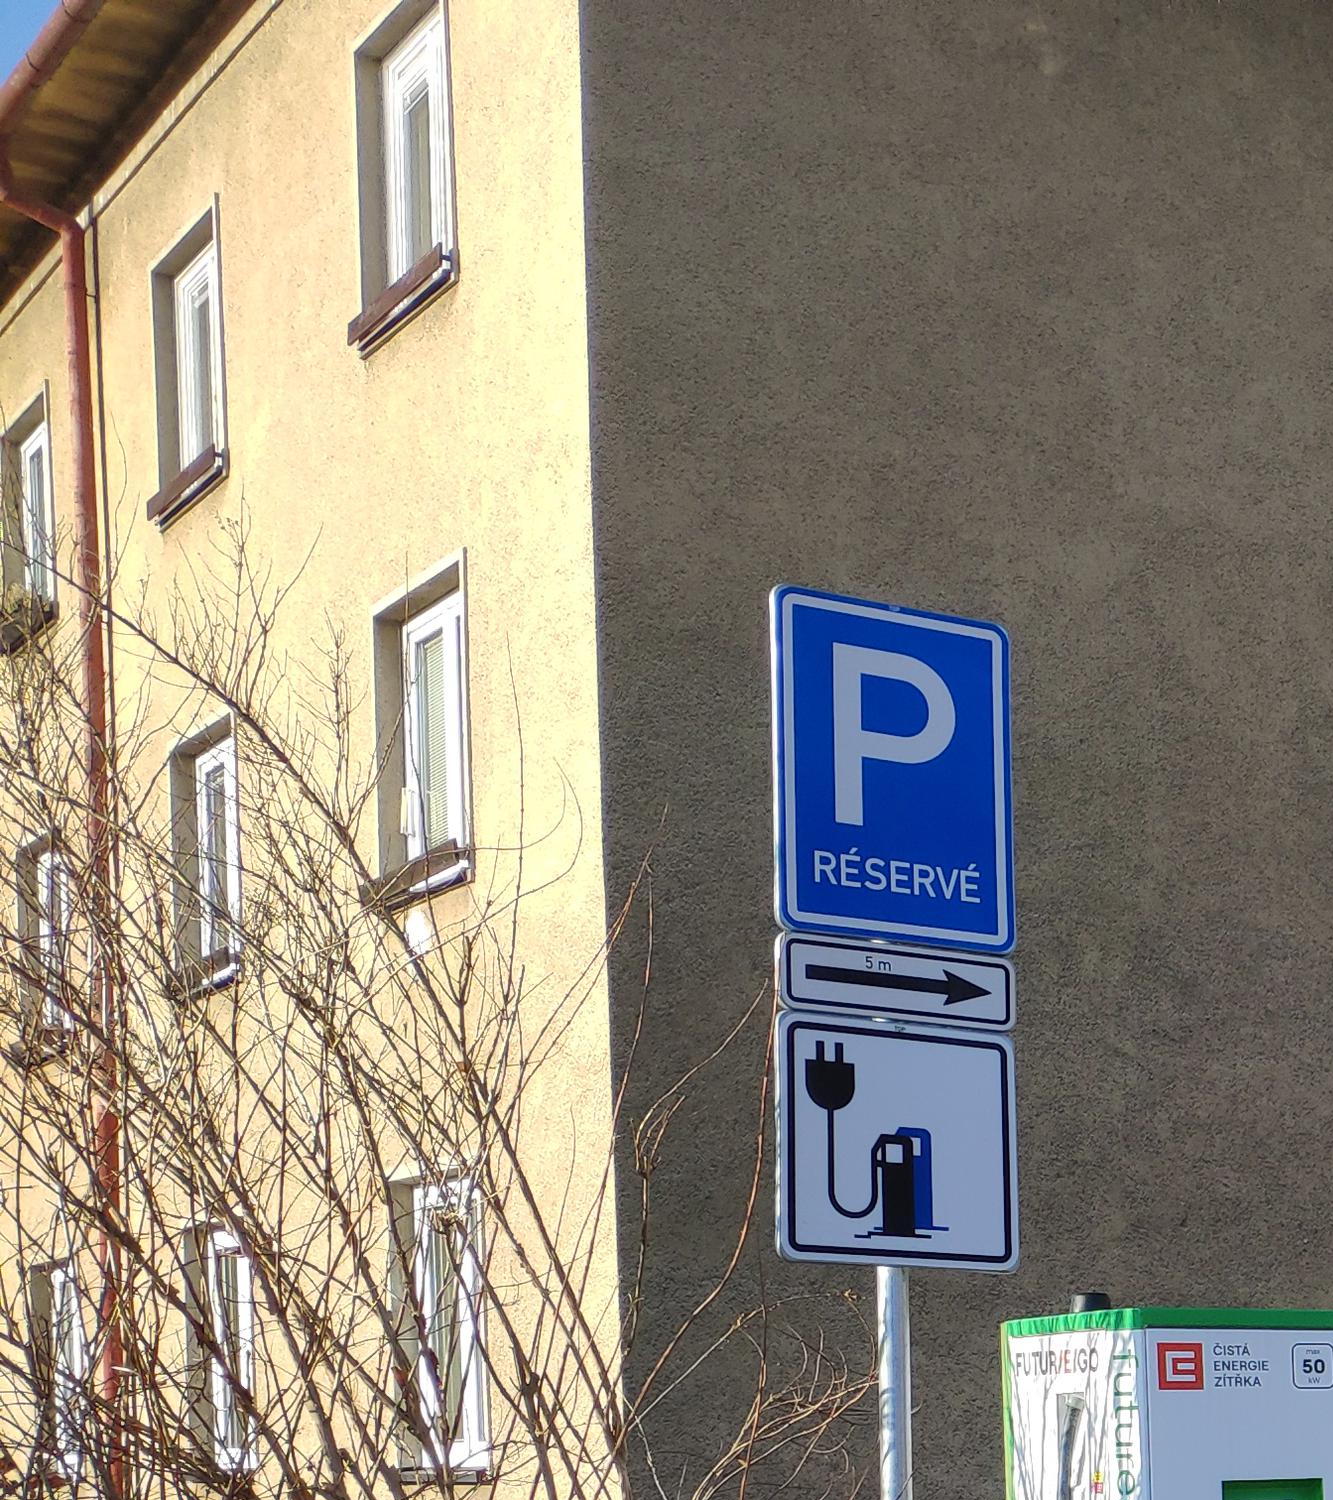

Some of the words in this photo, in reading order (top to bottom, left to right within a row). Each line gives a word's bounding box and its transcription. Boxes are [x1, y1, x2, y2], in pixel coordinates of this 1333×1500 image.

[833, 641, 956, 826] P
[813, 847, 981, 904] RÉSERVÉ
[865, 956, 873, 969] 5
[878, 960, 891, 971] m
[1213, 1343, 1250, 1356] ČISTÁ
[1213, 1360, 1269, 1371] ENERGIE
[1302, 1359, 1325, 1373] 50
[1214, 1374, 1261, 1387] ZÍTŘKA
